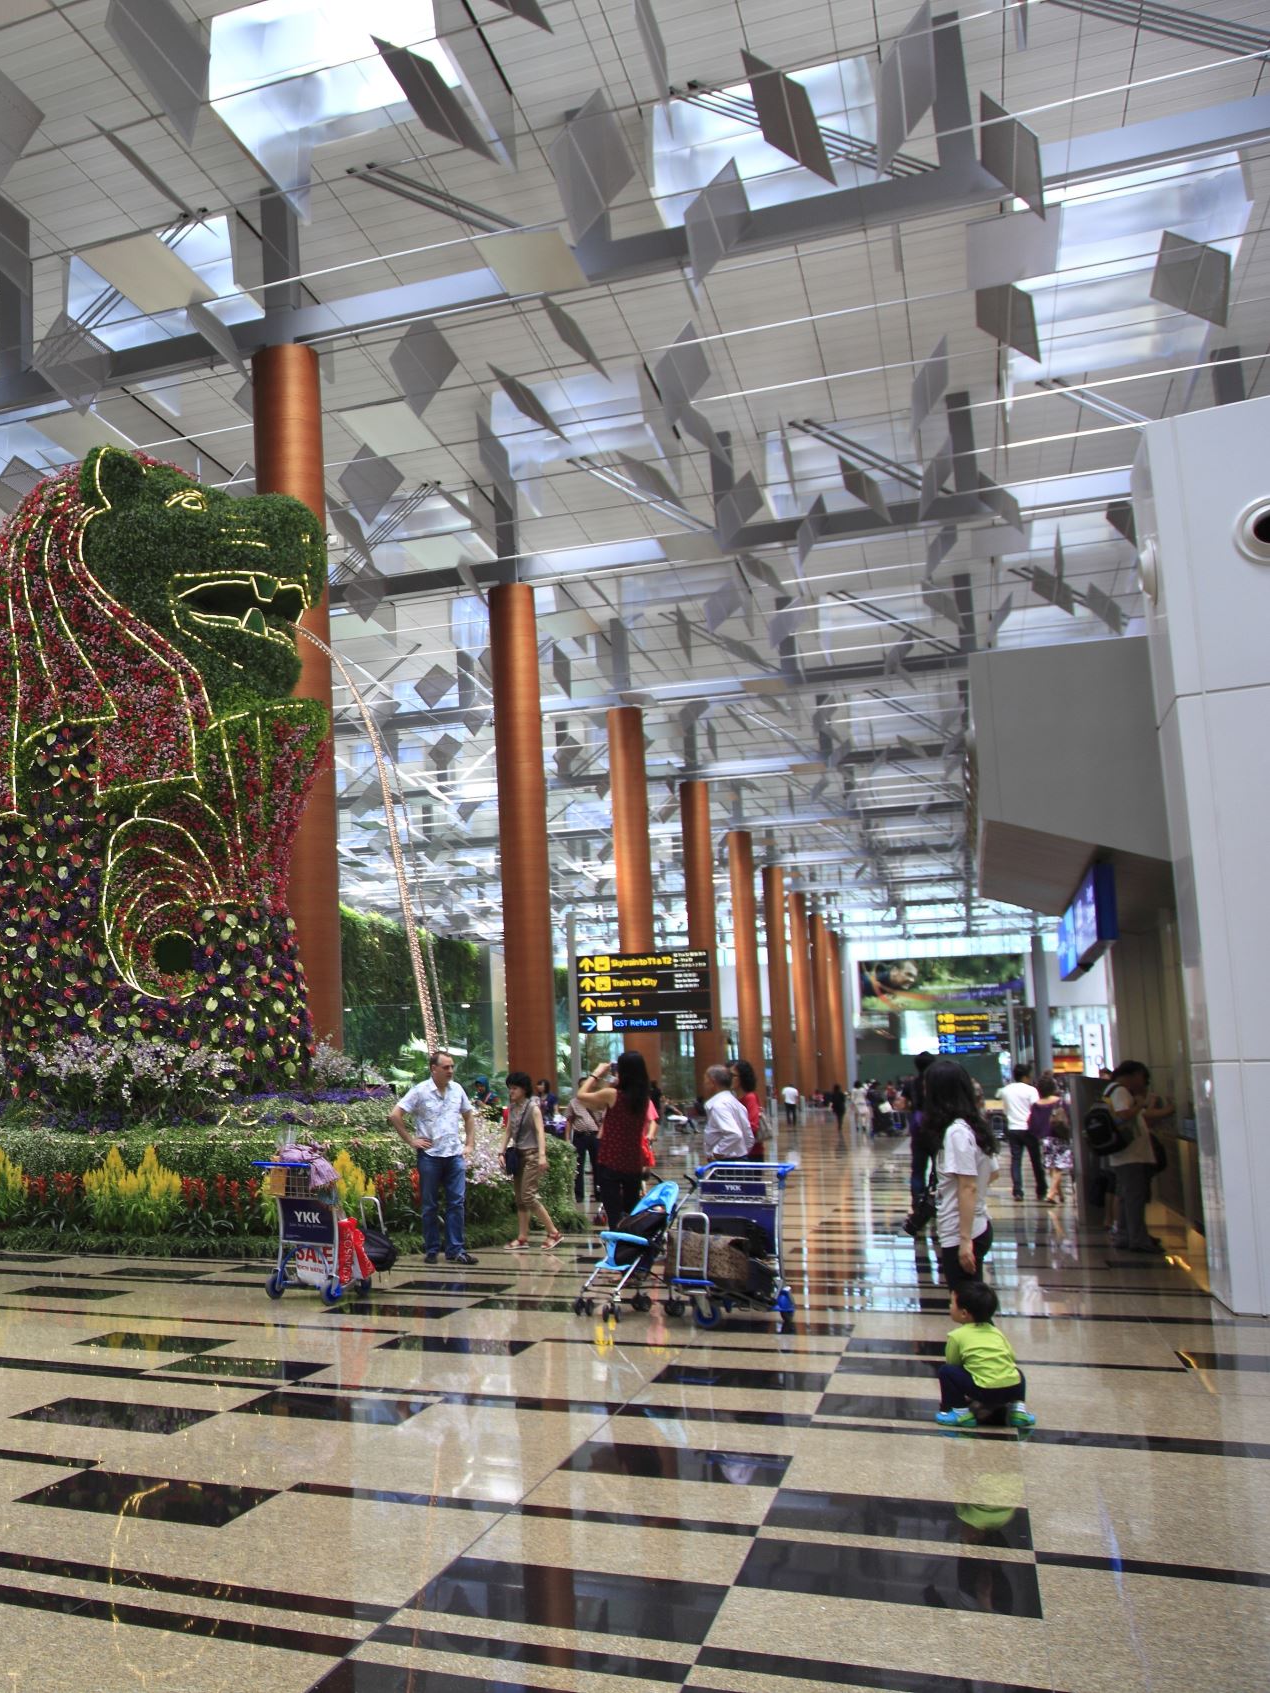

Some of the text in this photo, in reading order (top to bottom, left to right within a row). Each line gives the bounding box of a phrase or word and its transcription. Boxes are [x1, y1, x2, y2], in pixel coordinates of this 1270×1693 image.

[638, 958, 647, 966] to
[647, 957, 656, 965] T1
[661, 956, 672, 965] T2
[611, 979, 631, 987] Train
[641, 978, 658, 988] City
[597, 999, 618, 1008] Rows
[619, 998, 626, 1007] 6
[632, 999, 640, 1007] 11
[614, 1018, 658, 1027] GST Refund
[294, 1211, 321, 1223] YKK
